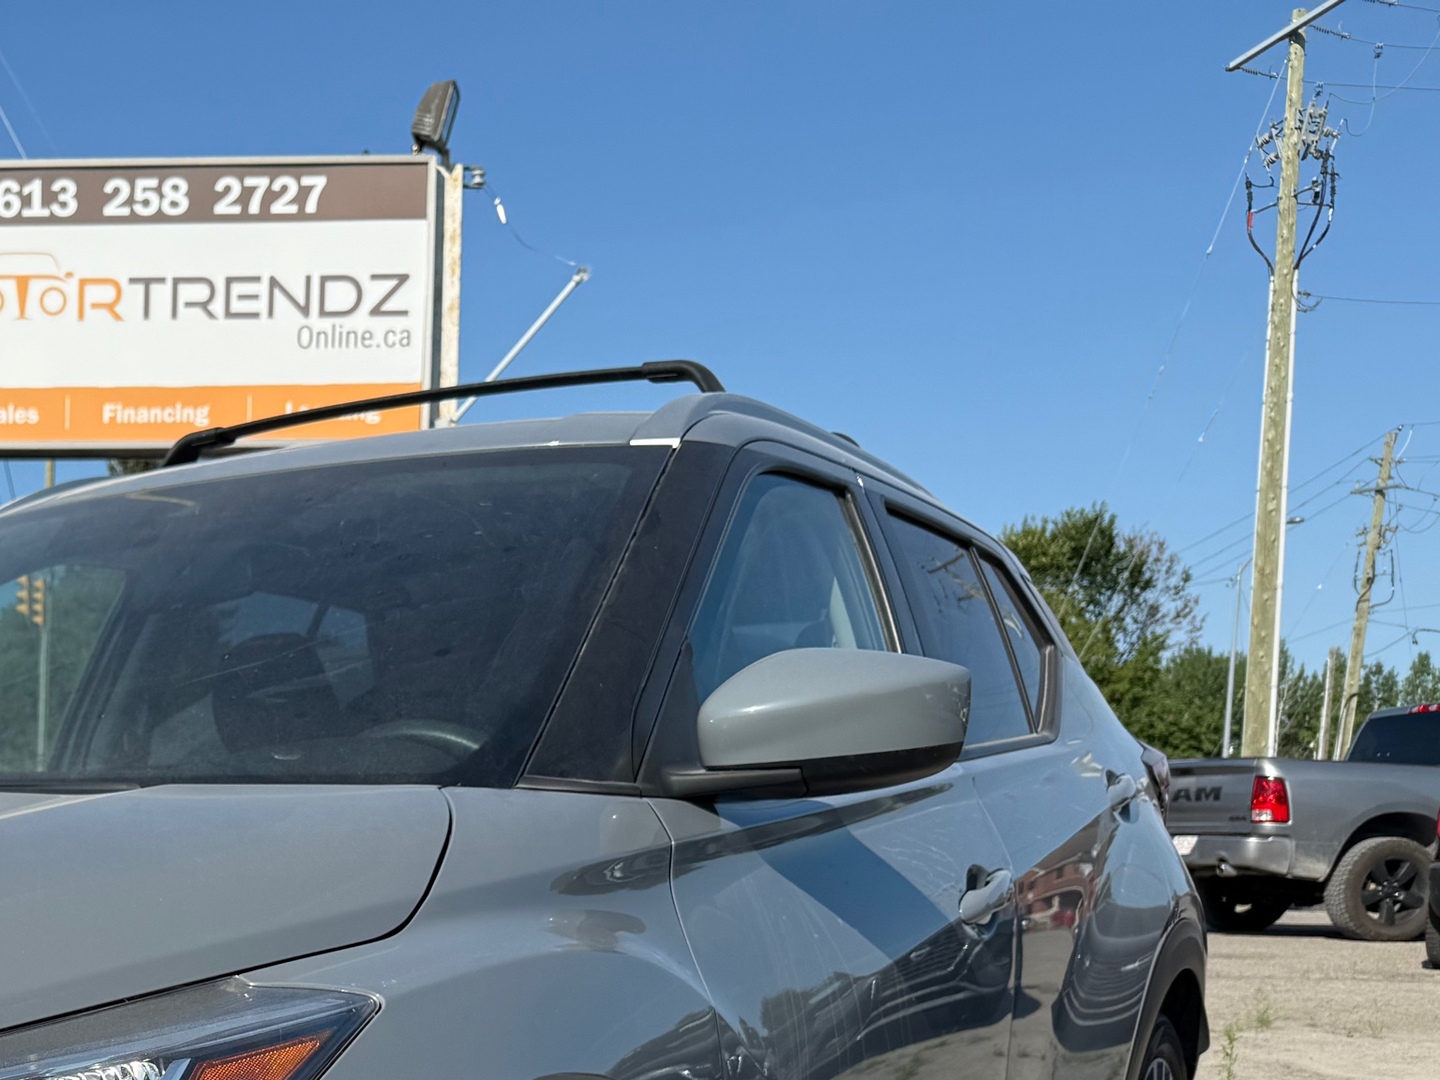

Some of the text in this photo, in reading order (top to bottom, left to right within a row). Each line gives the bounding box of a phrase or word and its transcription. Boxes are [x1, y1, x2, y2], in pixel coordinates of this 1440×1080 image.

[102, 176, 189, 217] 258
[213, 175, 328, 215] 2727
[296, 325, 411, 350] Online.ca
[102, 401, 210, 427] Financing
